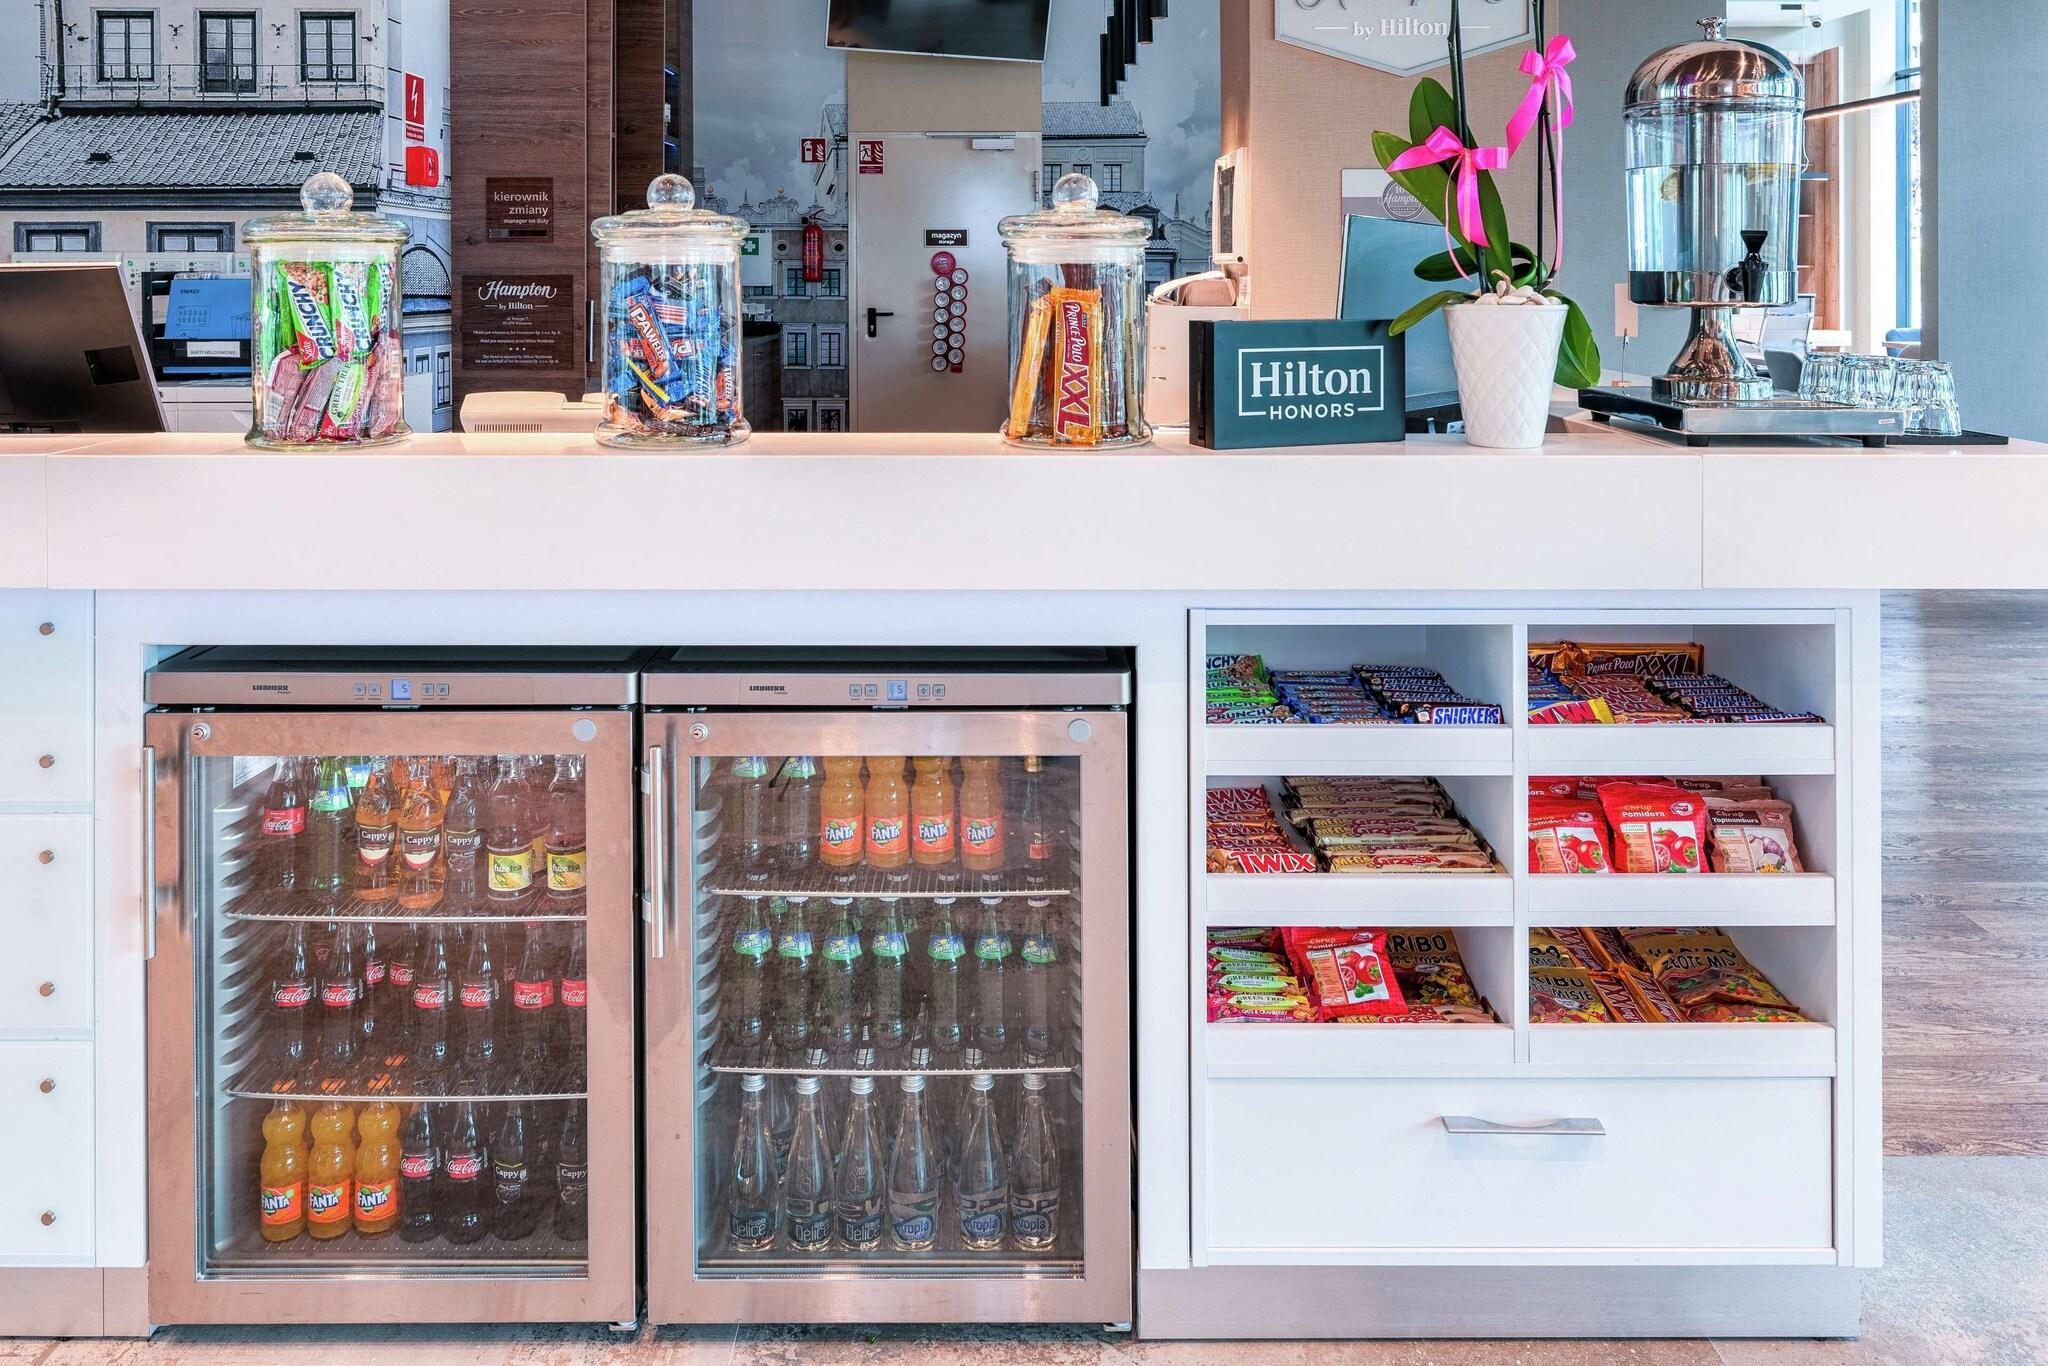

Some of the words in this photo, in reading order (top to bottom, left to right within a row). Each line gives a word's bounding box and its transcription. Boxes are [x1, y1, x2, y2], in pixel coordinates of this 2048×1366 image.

[1352, 22, 1373, 40] by
[1380, 17, 1449, 36] Hilton
[494, 192, 548, 201] kierownik
[509, 205, 548, 216] zmiany
[478, 280, 558, 300] Hampton
[508, 302, 534, 310] Hilton
[288, 281, 337, 359] CRUNCHY
[1250, 360, 1372, 398] Hilton
[1056, 362, 1092, 436] XXL
[1270, 402, 1355, 420] HONORS
[1635, 653, 1696, 676] XXL
[1434, 707, 1500, 724] SNICKERS
[1683, 780, 1710, 788] Chrup
[1622, 810, 1666, 818] Pomidora
[1716, 810, 1744, 818] Chrup
[361, 830, 388, 842] Cappy
[826, 826, 855, 842] FANTA
[872, 825, 901, 841] FANTA
[918, 822, 948, 838] FANTA
[966, 826, 996, 842] FANTA
[406, 836, 434, 845] Cappy
[448, 836, 472, 846] Cappy
[1229, 850, 1316, 874] TWIX
[275, 986, 312, 1002] Coca-Cola
[322, 986, 358, 1002] Coca-Cola
[414, 986, 447, 1004] Coca-Cola
[460, 987, 493, 1004] Coca-Cola
[514, 991, 542, 1004] Coca-Cola
[1552, 988, 1594, 1001] MISIE
[401, 1156, 435, 1174] Coca-Cola
[448, 1156, 484, 1174] Coca-Cola
[496, 1167, 518, 1179] Cappy
[561, 1168, 586, 1178] Cappy
[310, 1192, 338, 1208] FANTA
[358, 1190, 388, 1207] FANTA
